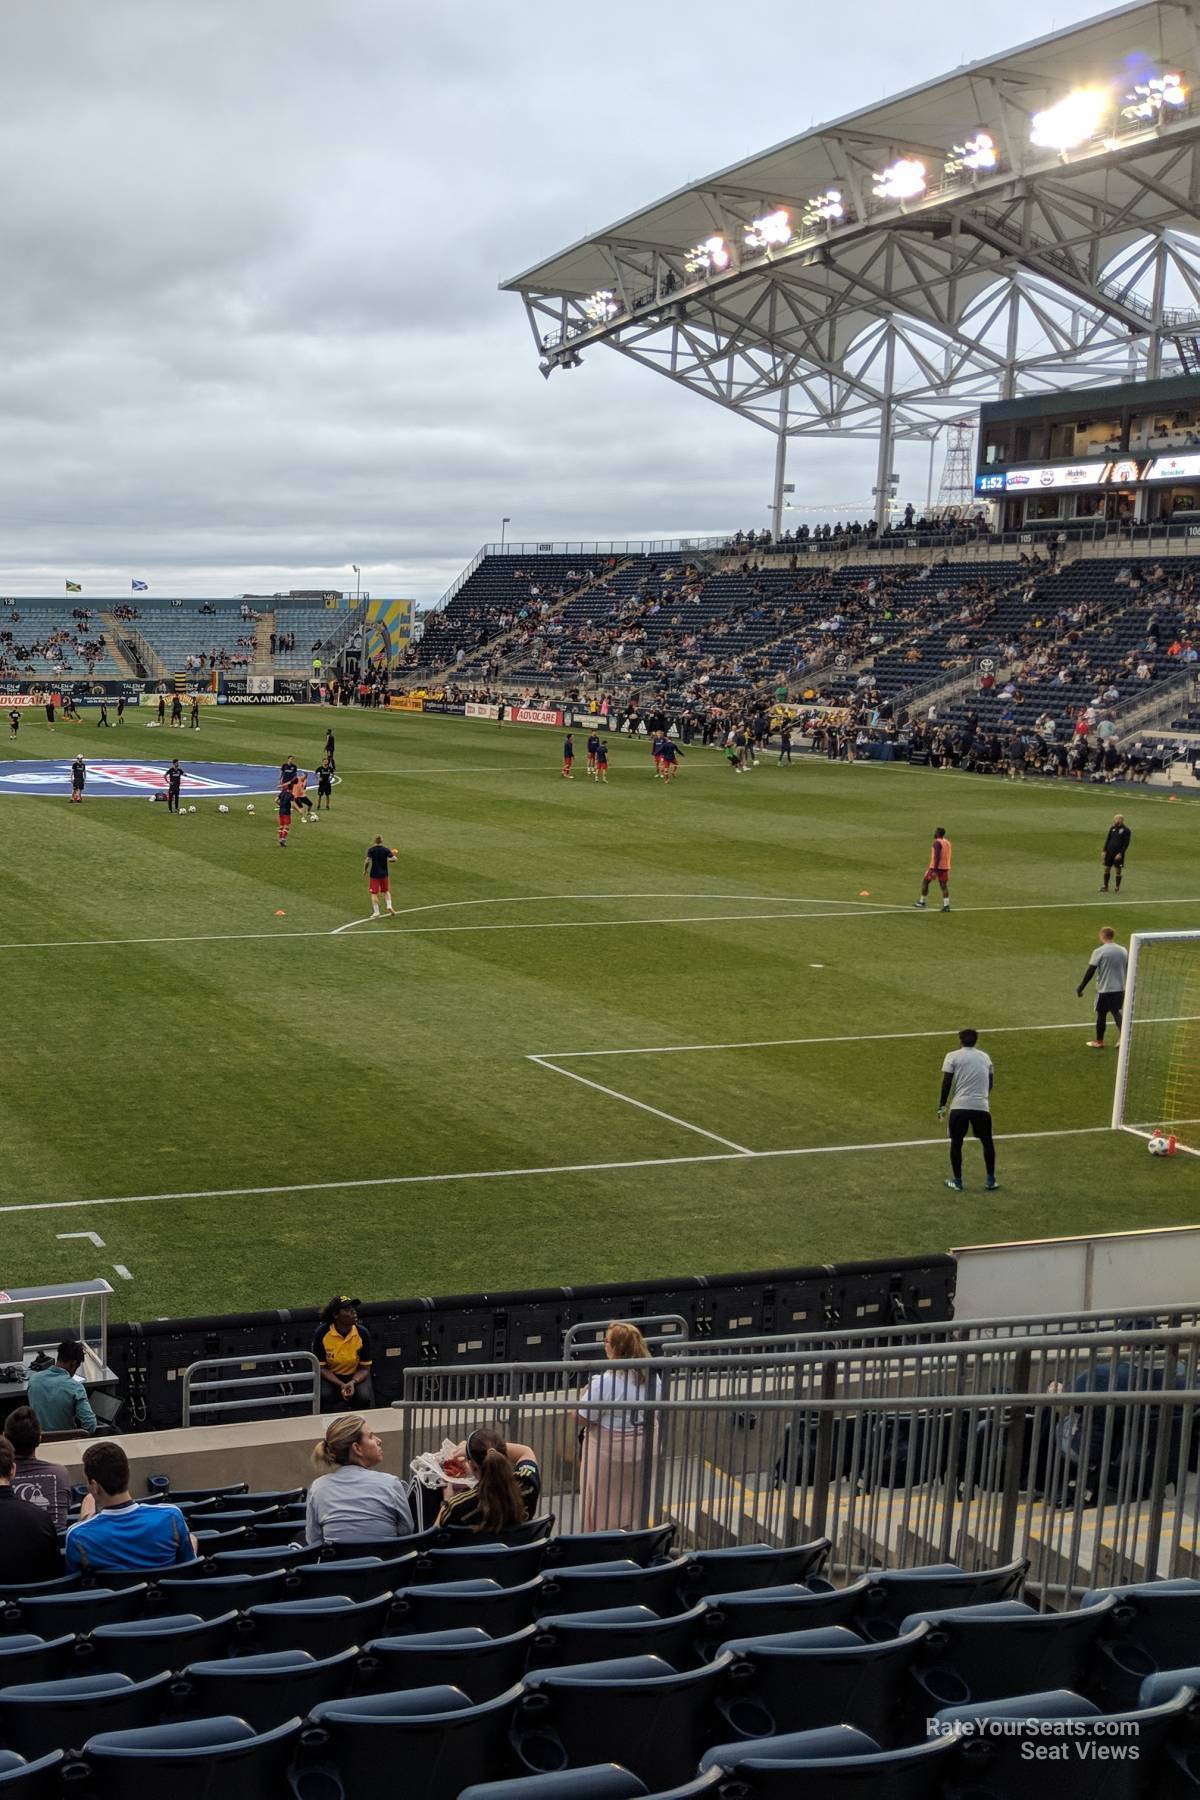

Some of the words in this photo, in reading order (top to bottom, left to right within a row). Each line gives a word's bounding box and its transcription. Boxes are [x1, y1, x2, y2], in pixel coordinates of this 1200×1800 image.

[980, 477, 1003, 490] 1:52
[1020, 535, 1032, 543] 105
[228, 695, 260, 704] KONICA
[260, 695, 295, 704] MINOLTA
[518, 709, 556, 724] ADVOCARE
